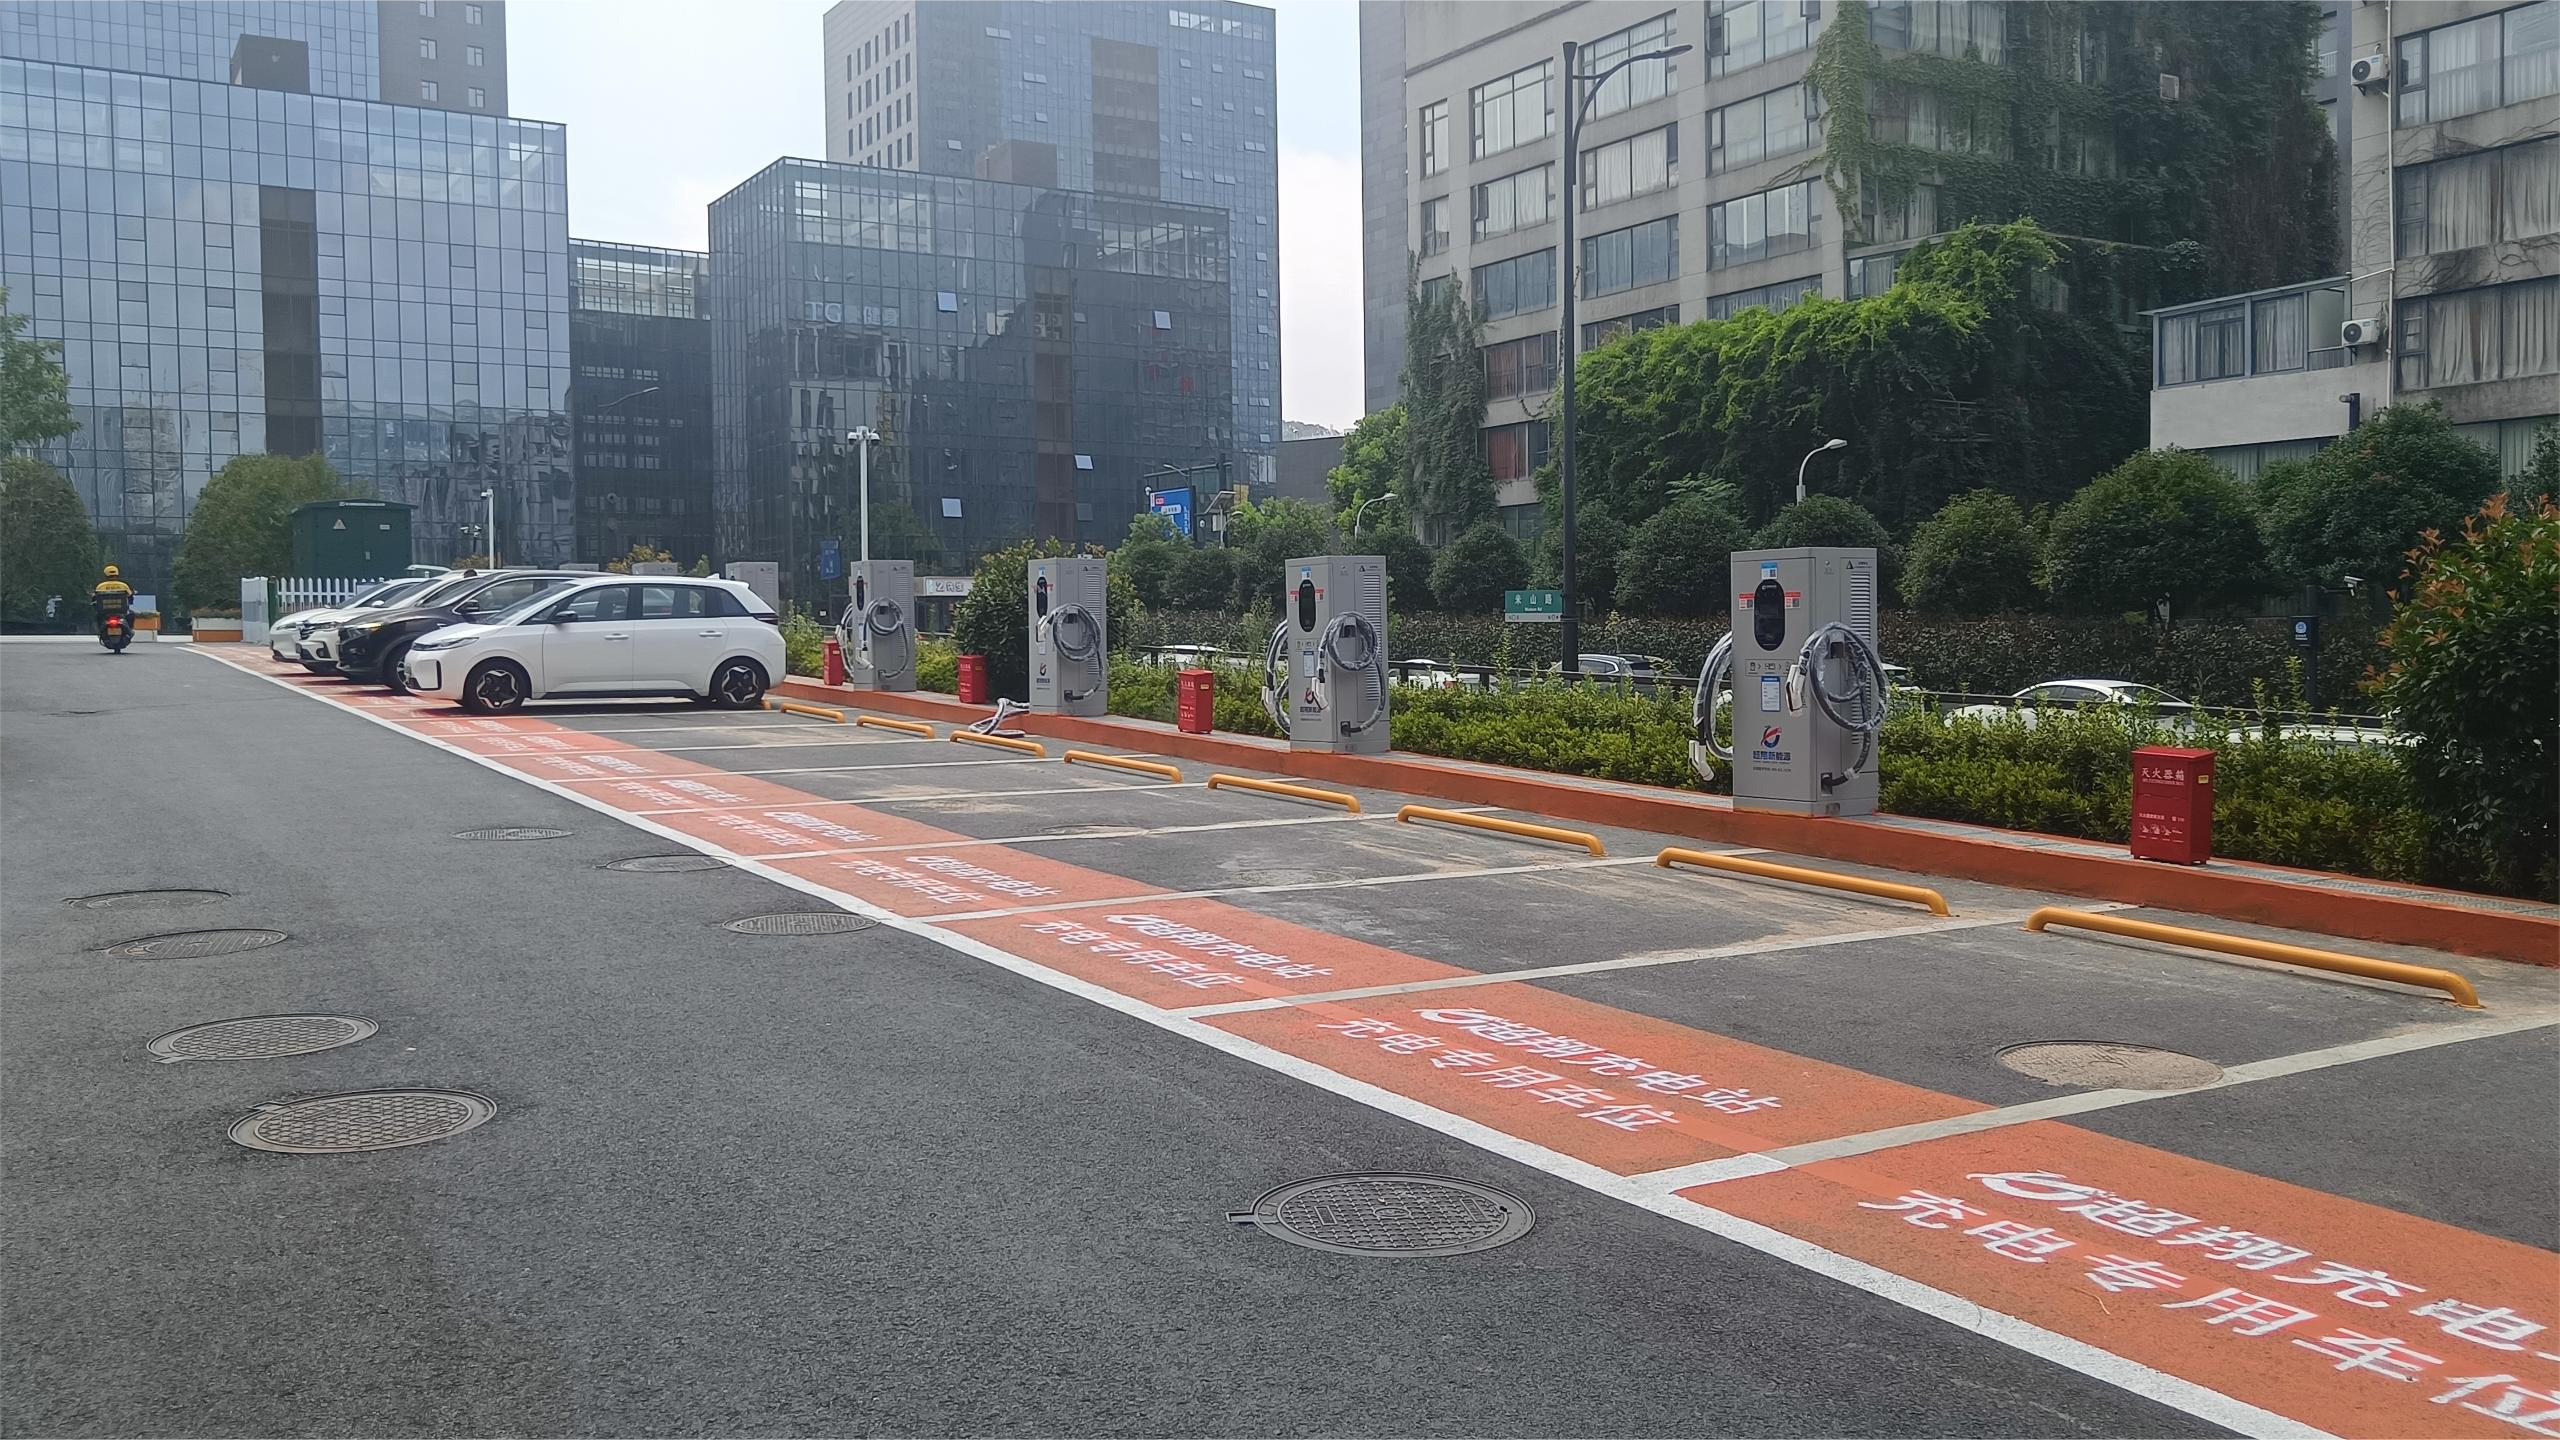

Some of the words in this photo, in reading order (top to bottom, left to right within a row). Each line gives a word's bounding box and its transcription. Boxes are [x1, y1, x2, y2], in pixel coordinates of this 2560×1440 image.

[1020, 919, 1245, 989] 充电专用车位
[1317, 1017, 1680, 1132] 充电专用车位
[1465, 1013, 1782, 1115] 超翔充电站
[2059, 1197, 2560, 1364] 超翔充电
